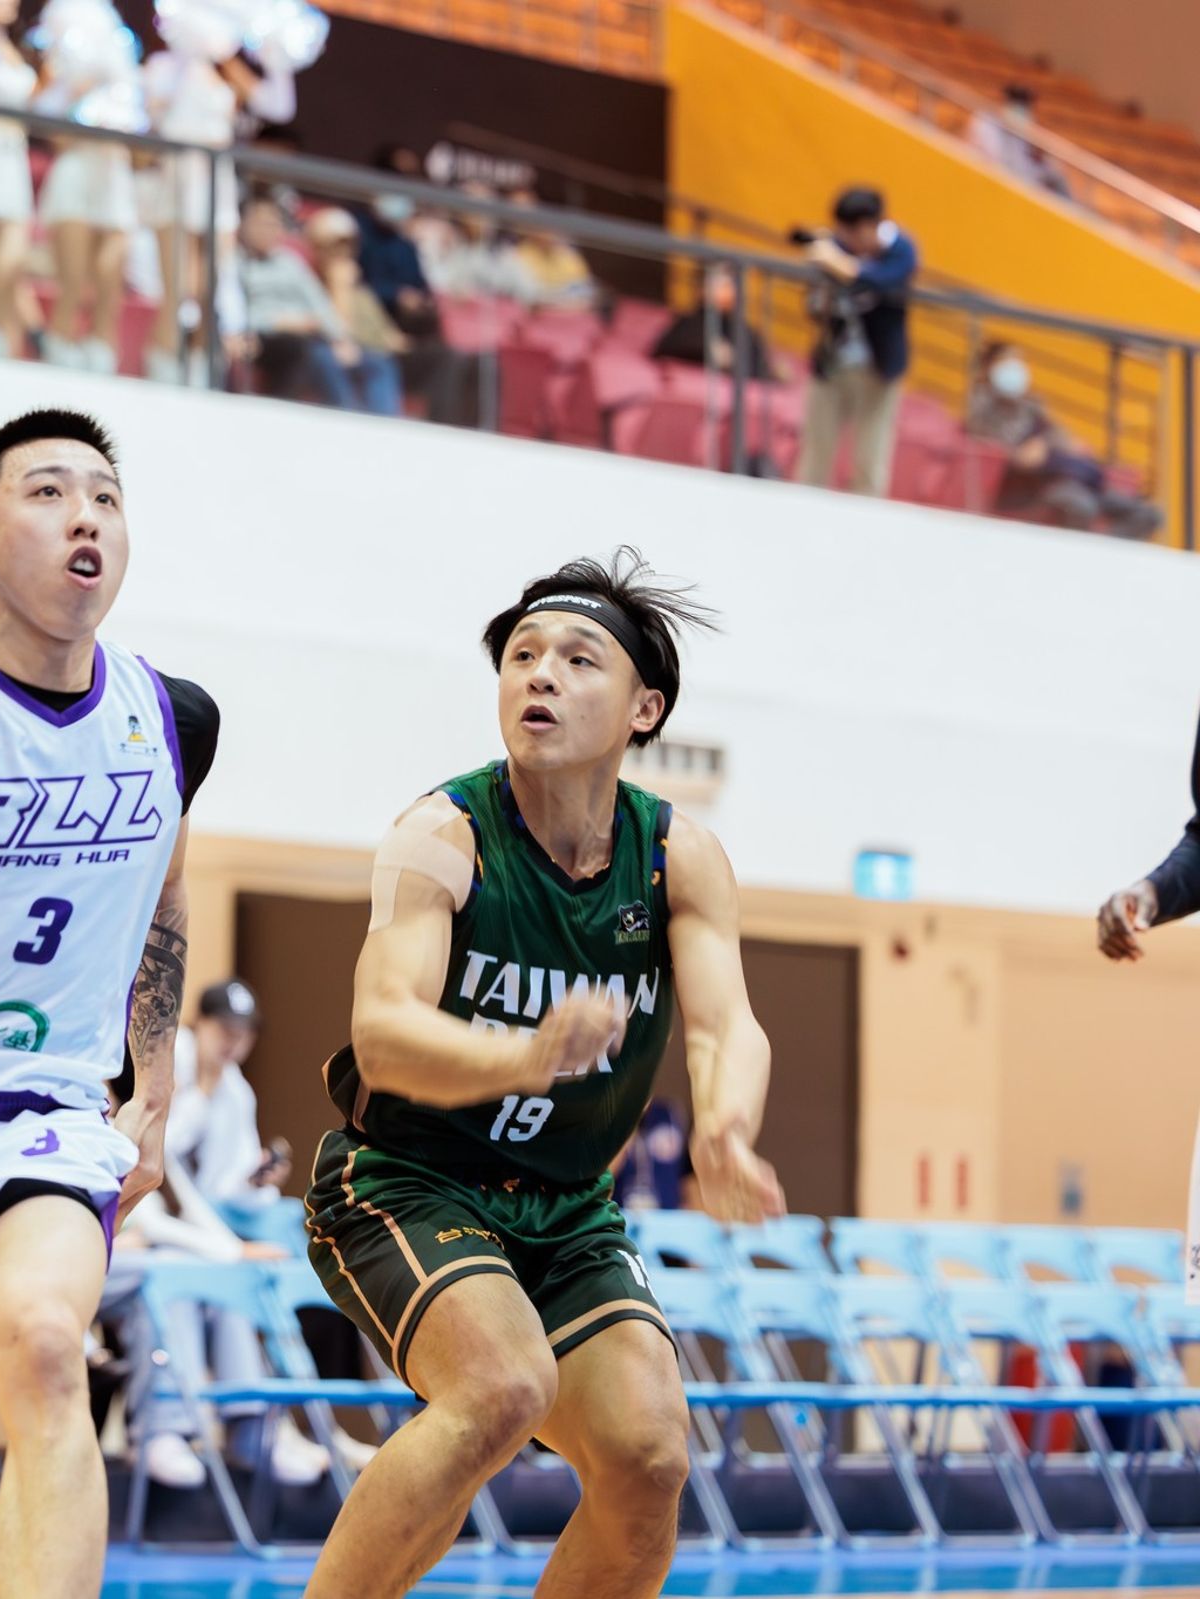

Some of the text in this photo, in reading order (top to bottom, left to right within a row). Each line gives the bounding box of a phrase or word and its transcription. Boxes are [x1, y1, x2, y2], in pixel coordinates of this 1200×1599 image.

[74, 849, 130, 864] HUA
[12, 896, 74, 966] 3
[489, 1094, 554, 1142] 19
[20, 1127, 60, 1157] 3
